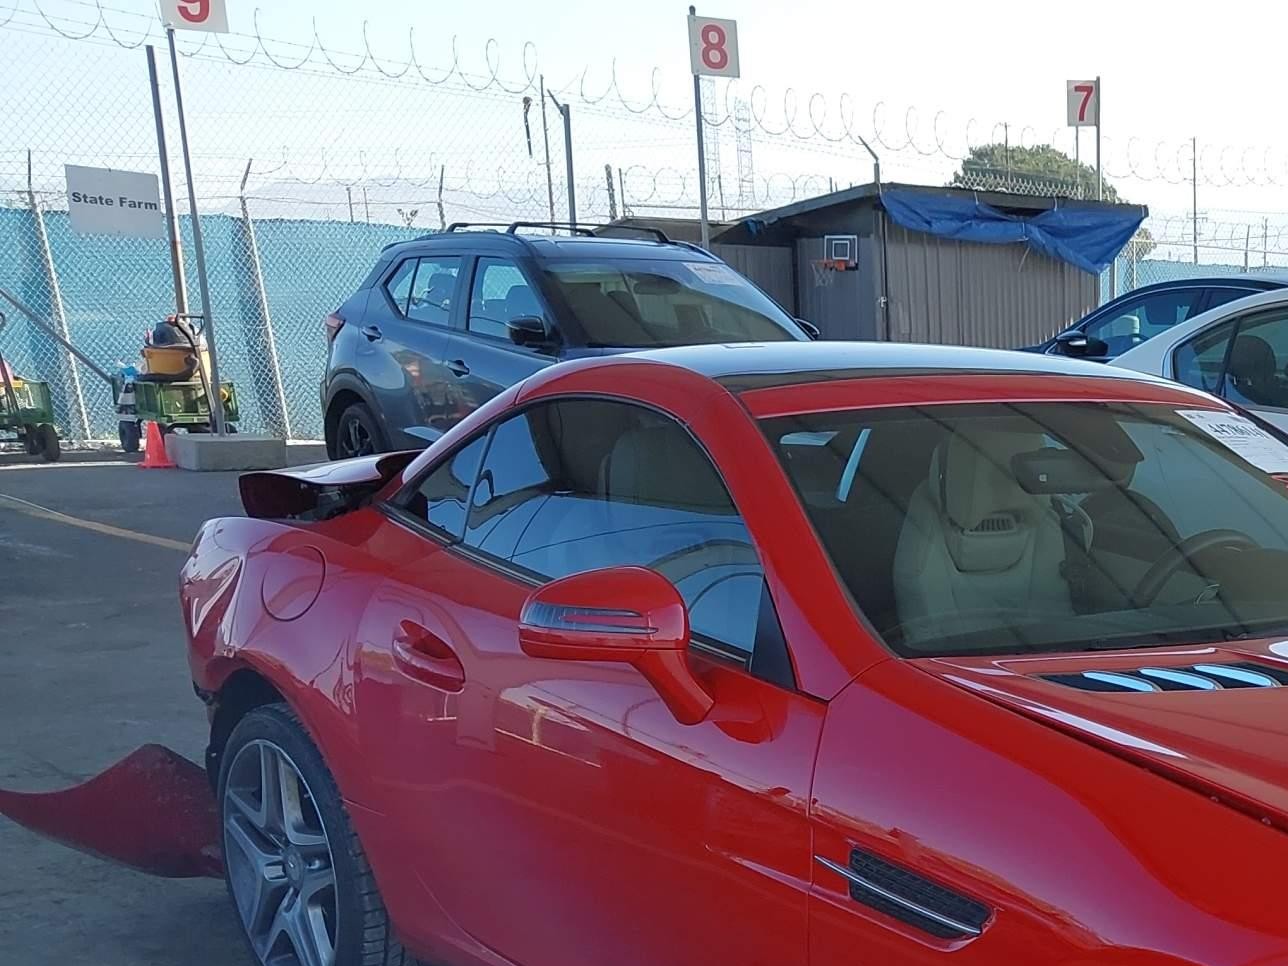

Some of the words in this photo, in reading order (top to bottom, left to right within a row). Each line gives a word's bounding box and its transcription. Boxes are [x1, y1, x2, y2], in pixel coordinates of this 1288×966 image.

[701, 24, 728, 69] 8
[1074, 85, 1094, 122] 7
[71, 191, 114, 206] State
[118, 197, 158, 210] Farm
